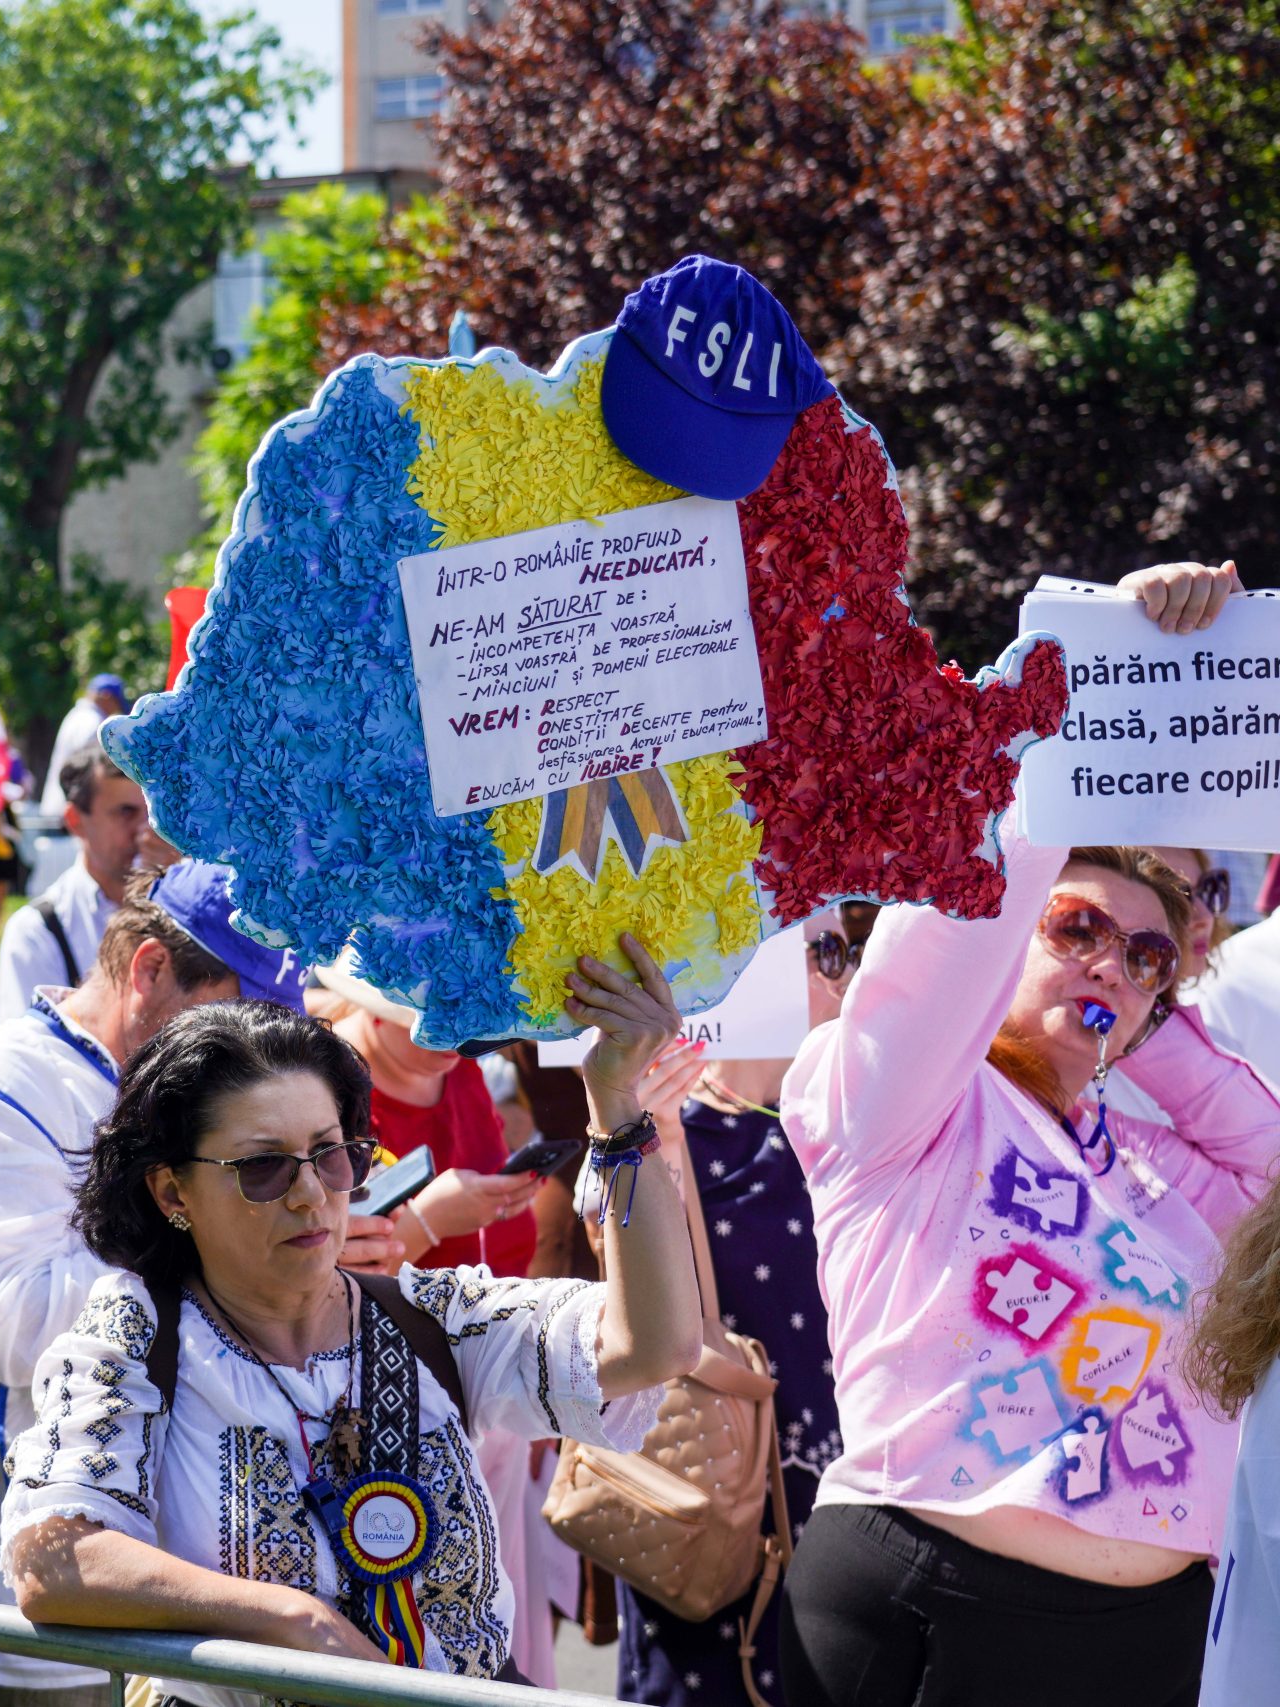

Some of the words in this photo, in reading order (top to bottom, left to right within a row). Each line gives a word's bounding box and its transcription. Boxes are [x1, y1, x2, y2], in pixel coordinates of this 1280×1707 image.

[664, 305, 782, 398] FSLI
[602, 528, 682, 557] PROFUND
[429, 612, 505, 647] NE-AM
[517, 590, 607, 632] SĂTURAT
[611, 603, 676, 632] VOASTRĂ
[515, 645, 577, 672] VOASTRĂ
[592, 642, 612, 657] DE
[655, 637, 739, 664] ELECTORALE
[540, 690, 620, 717] RESPECT
[620, 711, 692, 736] DECENTE
[700, 698, 748, 724] pentru
[1061, 709, 1158, 744] clasă,
[465, 777, 535, 805] EDUCĂM
[548, 772, 570, 786] CU
[1071, 767, 1189, 797] fiecare
[1200, 759, 1280, 798] copil!
[362, 1531, 405, 1541] ROMÂNIA
